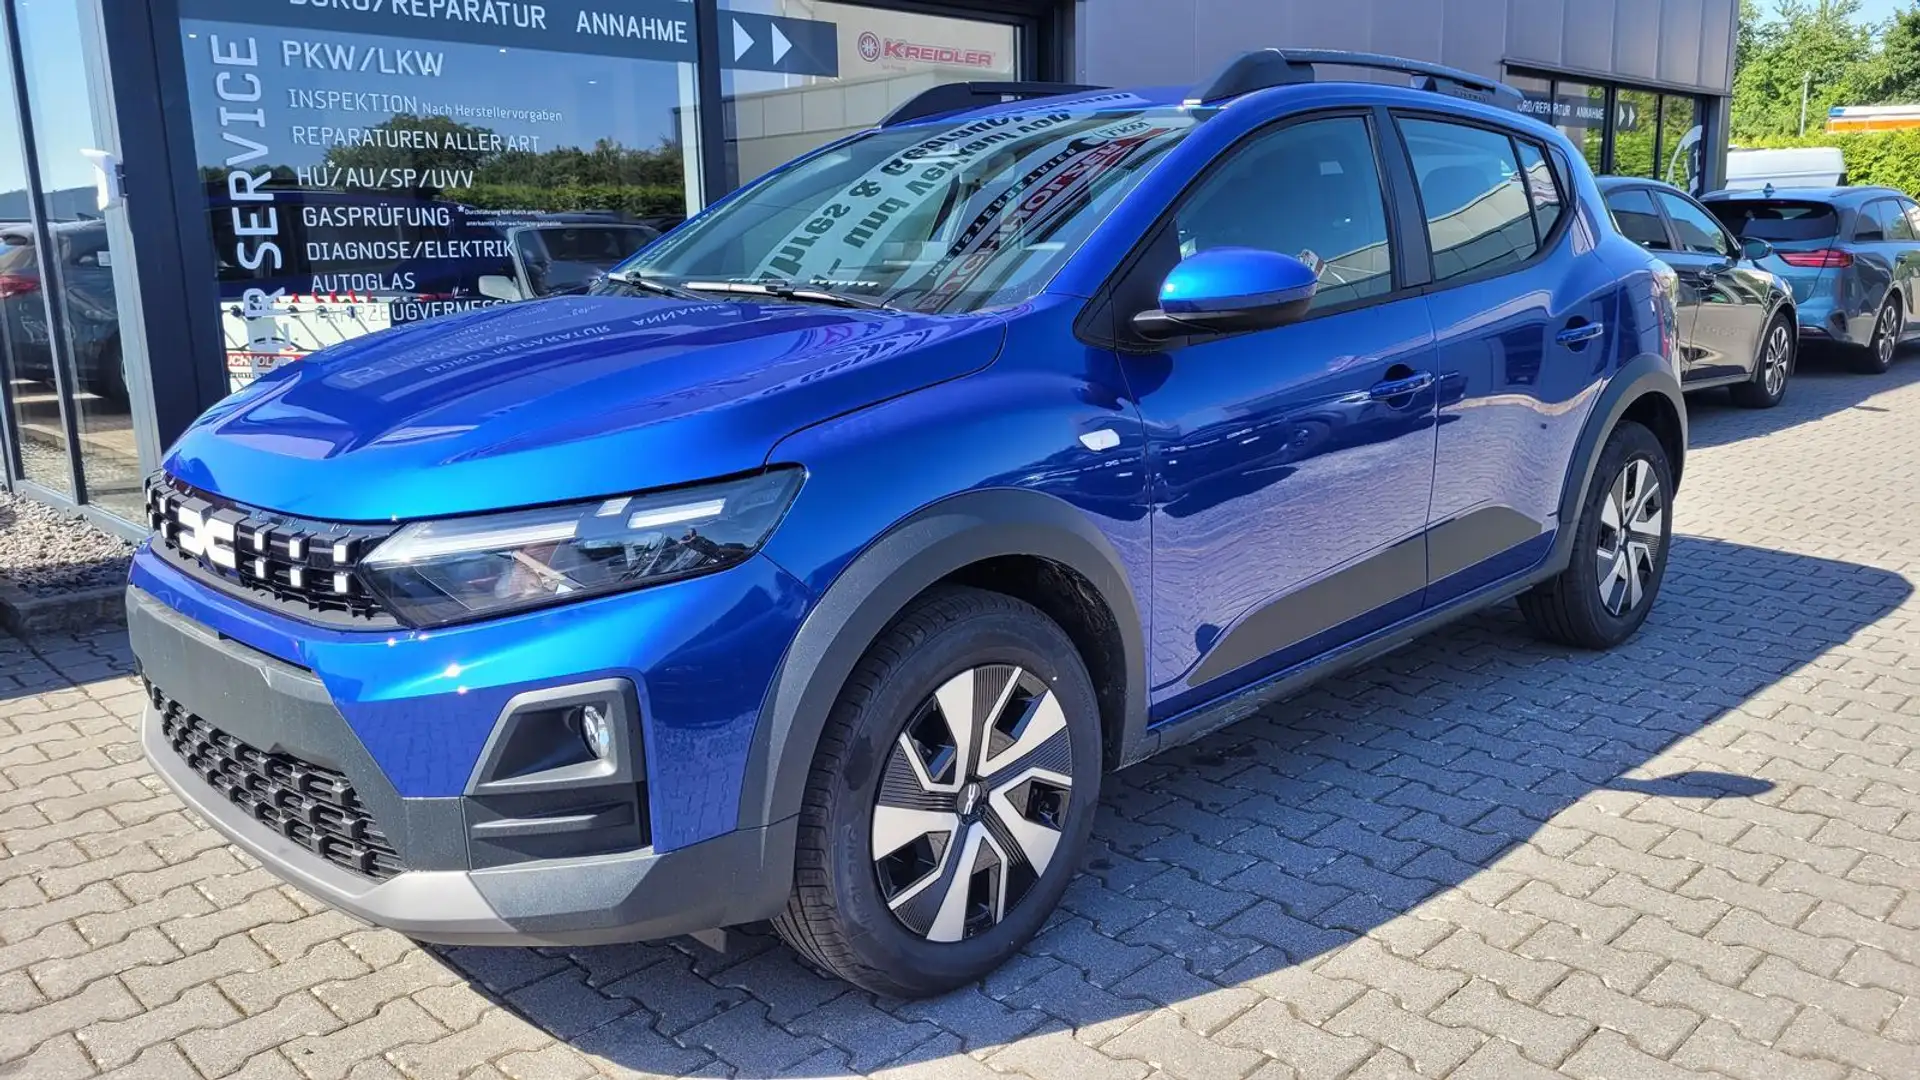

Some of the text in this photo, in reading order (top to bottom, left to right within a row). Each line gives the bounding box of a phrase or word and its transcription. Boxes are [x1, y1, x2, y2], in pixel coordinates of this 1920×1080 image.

[576, 10, 688, 44] ANNAHME
[282, 40, 444, 77] PKW/LKW
[884, 39, 993, 67] KREIDLER
[288, 88, 563, 123] INSPEKTION Nach Herstellervorgaben
[210, 34, 283, 270] SERVICE
[292, 125, 540, 154] REPARATUREN ALLER ART
[302, 203, 451, 228] GASPRÜFUNG
[306, 240, 515, 262] DIAGNOSE/ELEKTRIK
[311, 272, 416, 293] AUTOGLAS
